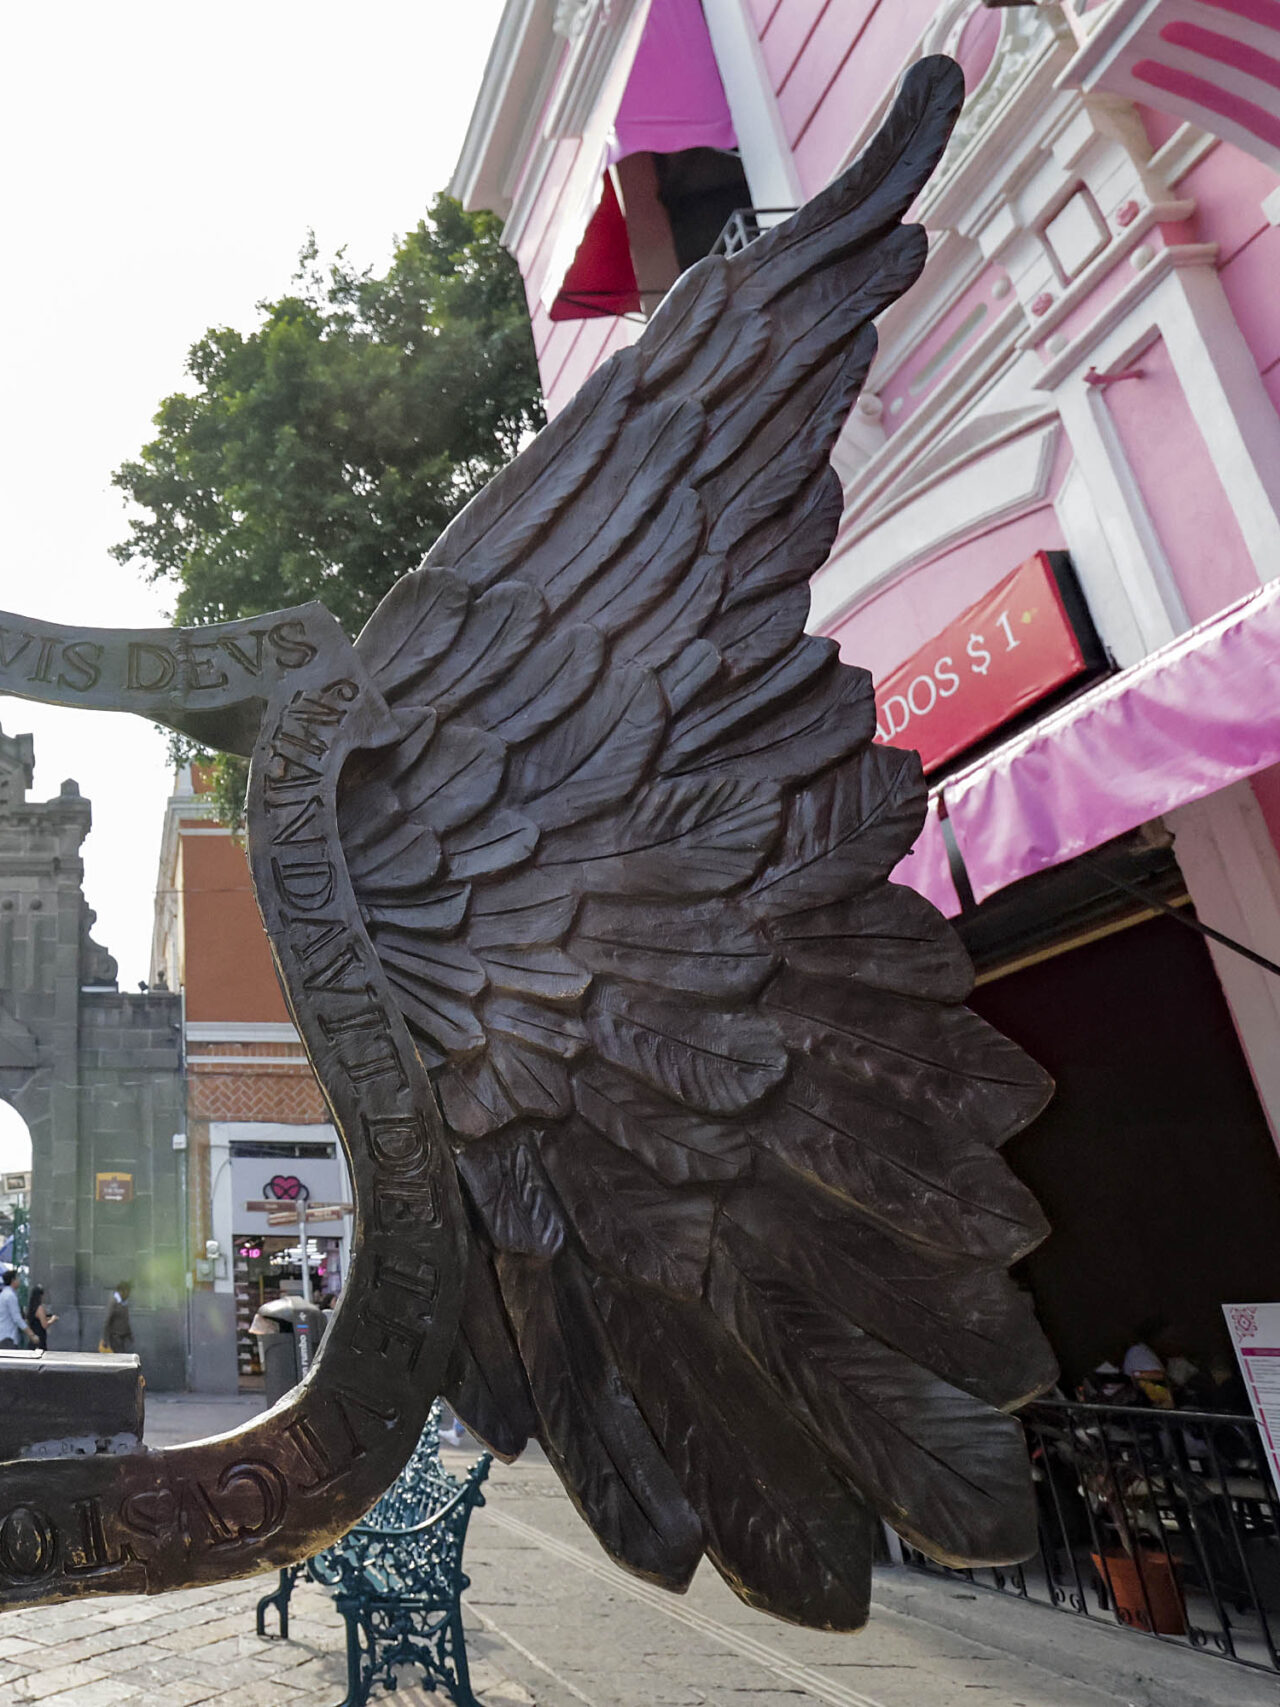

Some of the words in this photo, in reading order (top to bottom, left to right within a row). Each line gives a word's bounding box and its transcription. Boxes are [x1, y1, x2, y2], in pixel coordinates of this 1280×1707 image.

[126, 620, 320, 692] DEVS
[967, 633, 991, 675] $
[265, 678, 409, 1094] MANDAVIT
